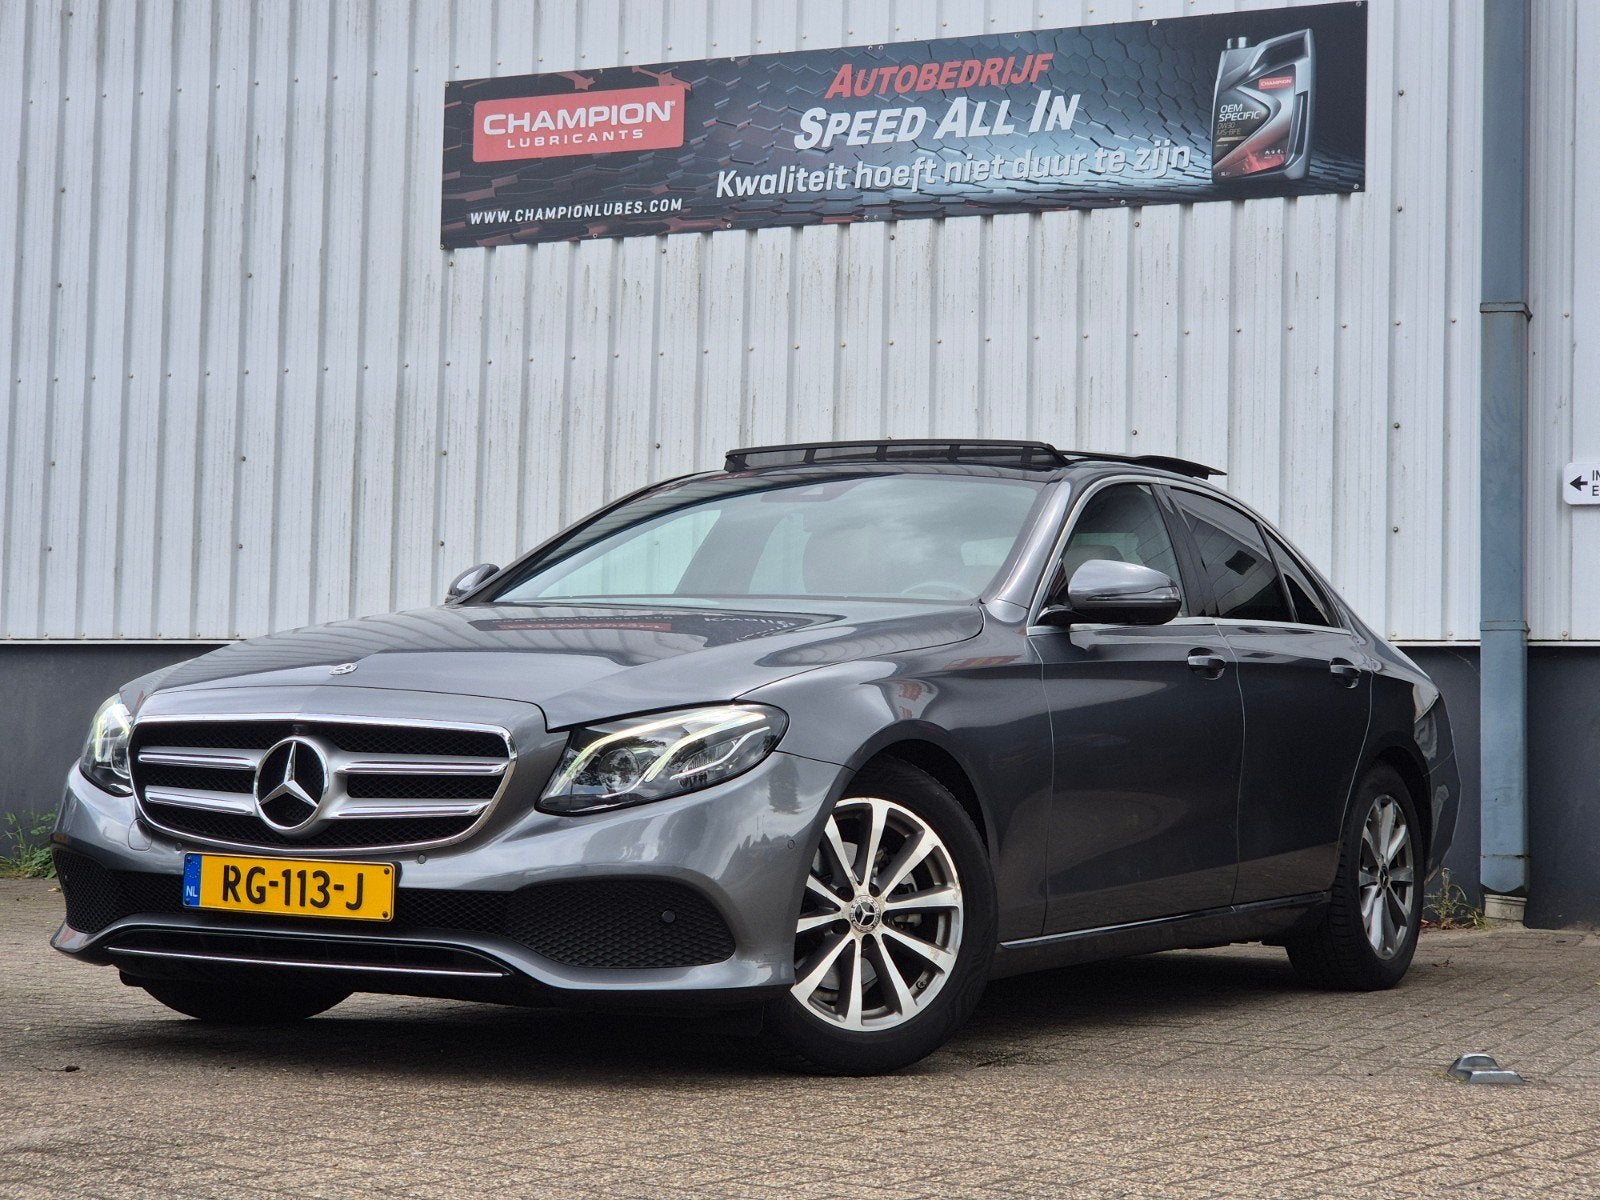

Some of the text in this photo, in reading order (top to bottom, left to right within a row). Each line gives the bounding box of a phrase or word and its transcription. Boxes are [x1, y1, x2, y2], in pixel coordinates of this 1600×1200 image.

[824, 53, 1053, 99] AUTOBEDRIJF
[1261, 79, 1292, 87] CHAMPION
[483, 100, 673, 135] CHAMPION
[794, 89, 1081, 150] SPEED ALL IN
[1218, 110, 1261, 122] SPECIFIC
[1220, 103, 1243, 114] OEM
[507, 129, 643, 149] LUBRICANTS
[716, 139, 1191, 198] Kwaliteit hoeft niet duur te zijn
[470, 197, 683, 225] WWW.CHAMPIONLUBES.COM
[186, 885, 198, 898] NL
[222, 864, 364, 911] RG-113-J
